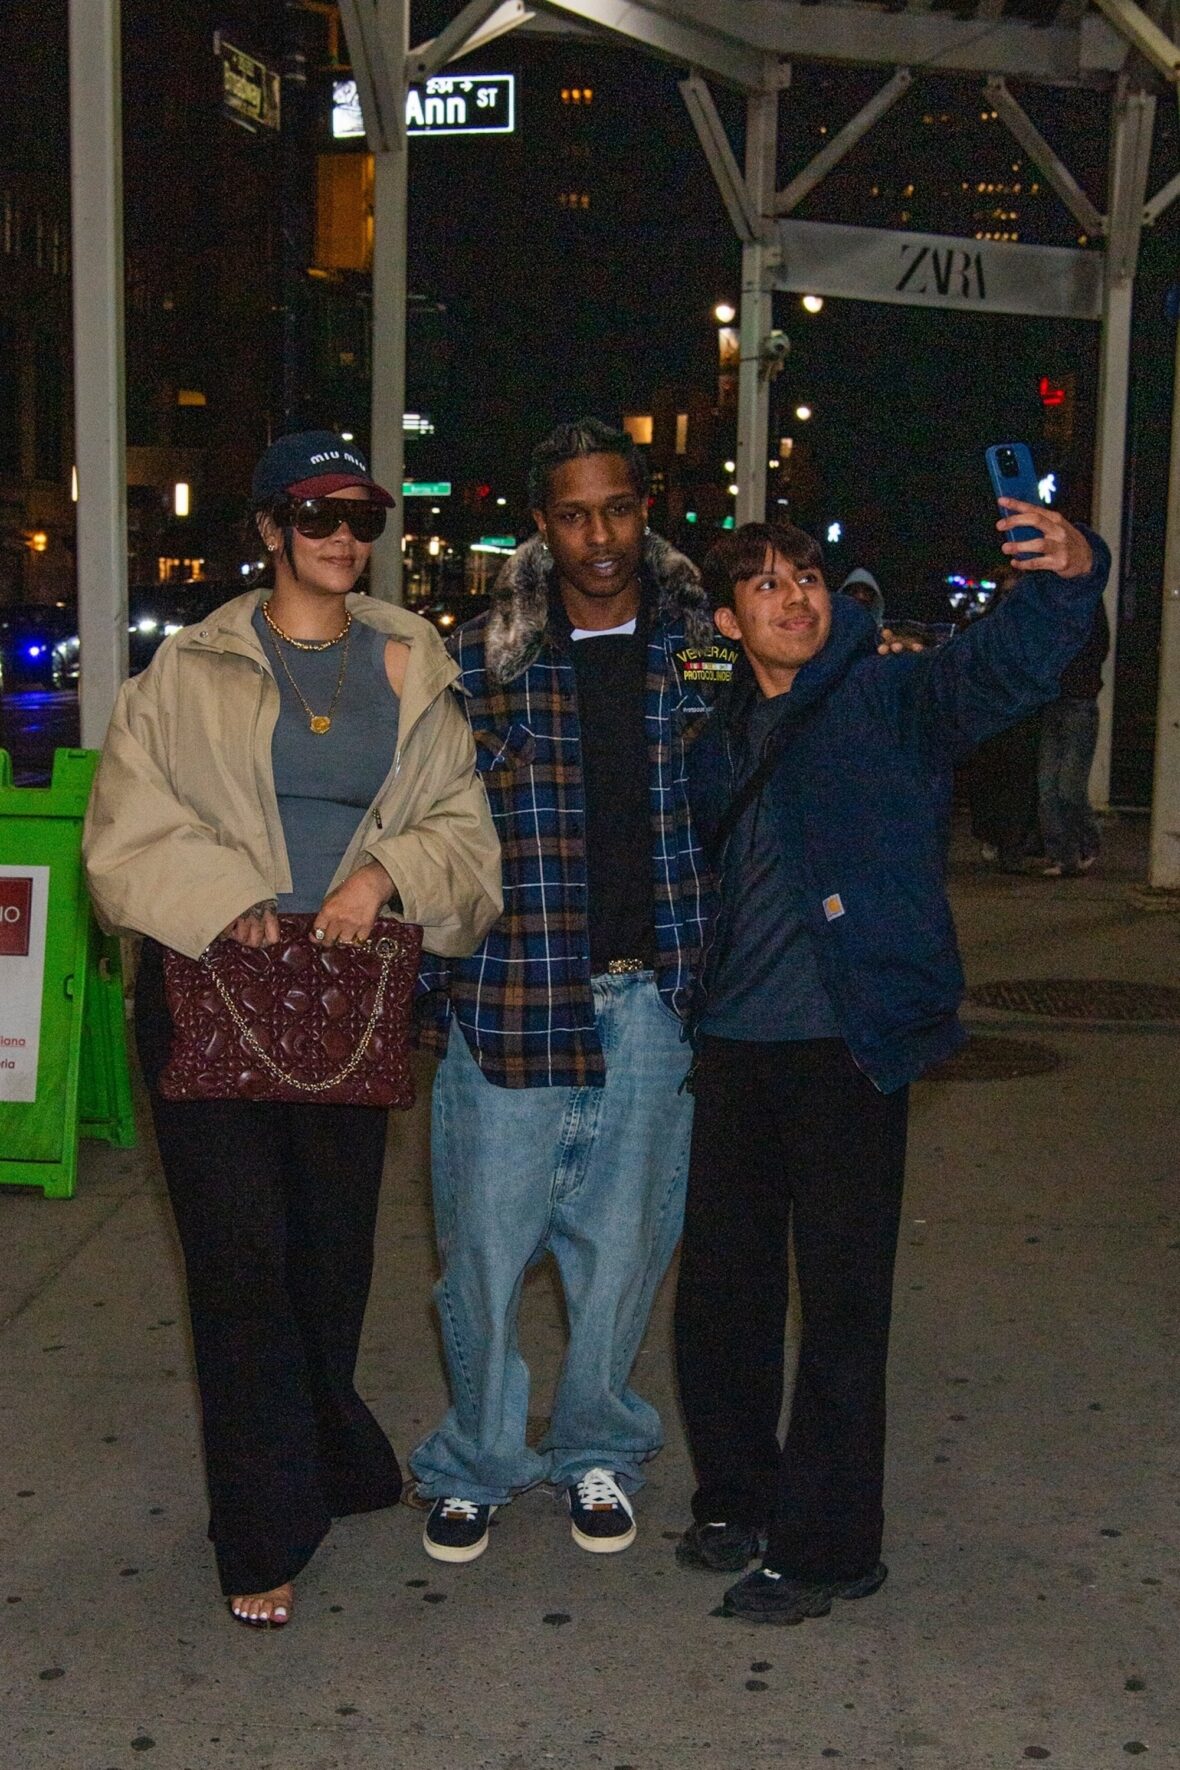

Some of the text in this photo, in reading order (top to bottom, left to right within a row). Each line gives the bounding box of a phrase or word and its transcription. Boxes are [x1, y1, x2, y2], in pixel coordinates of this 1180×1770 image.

[405, 87, 498, 125] Ann ST
[895, 244, 986, 300] ZARA
